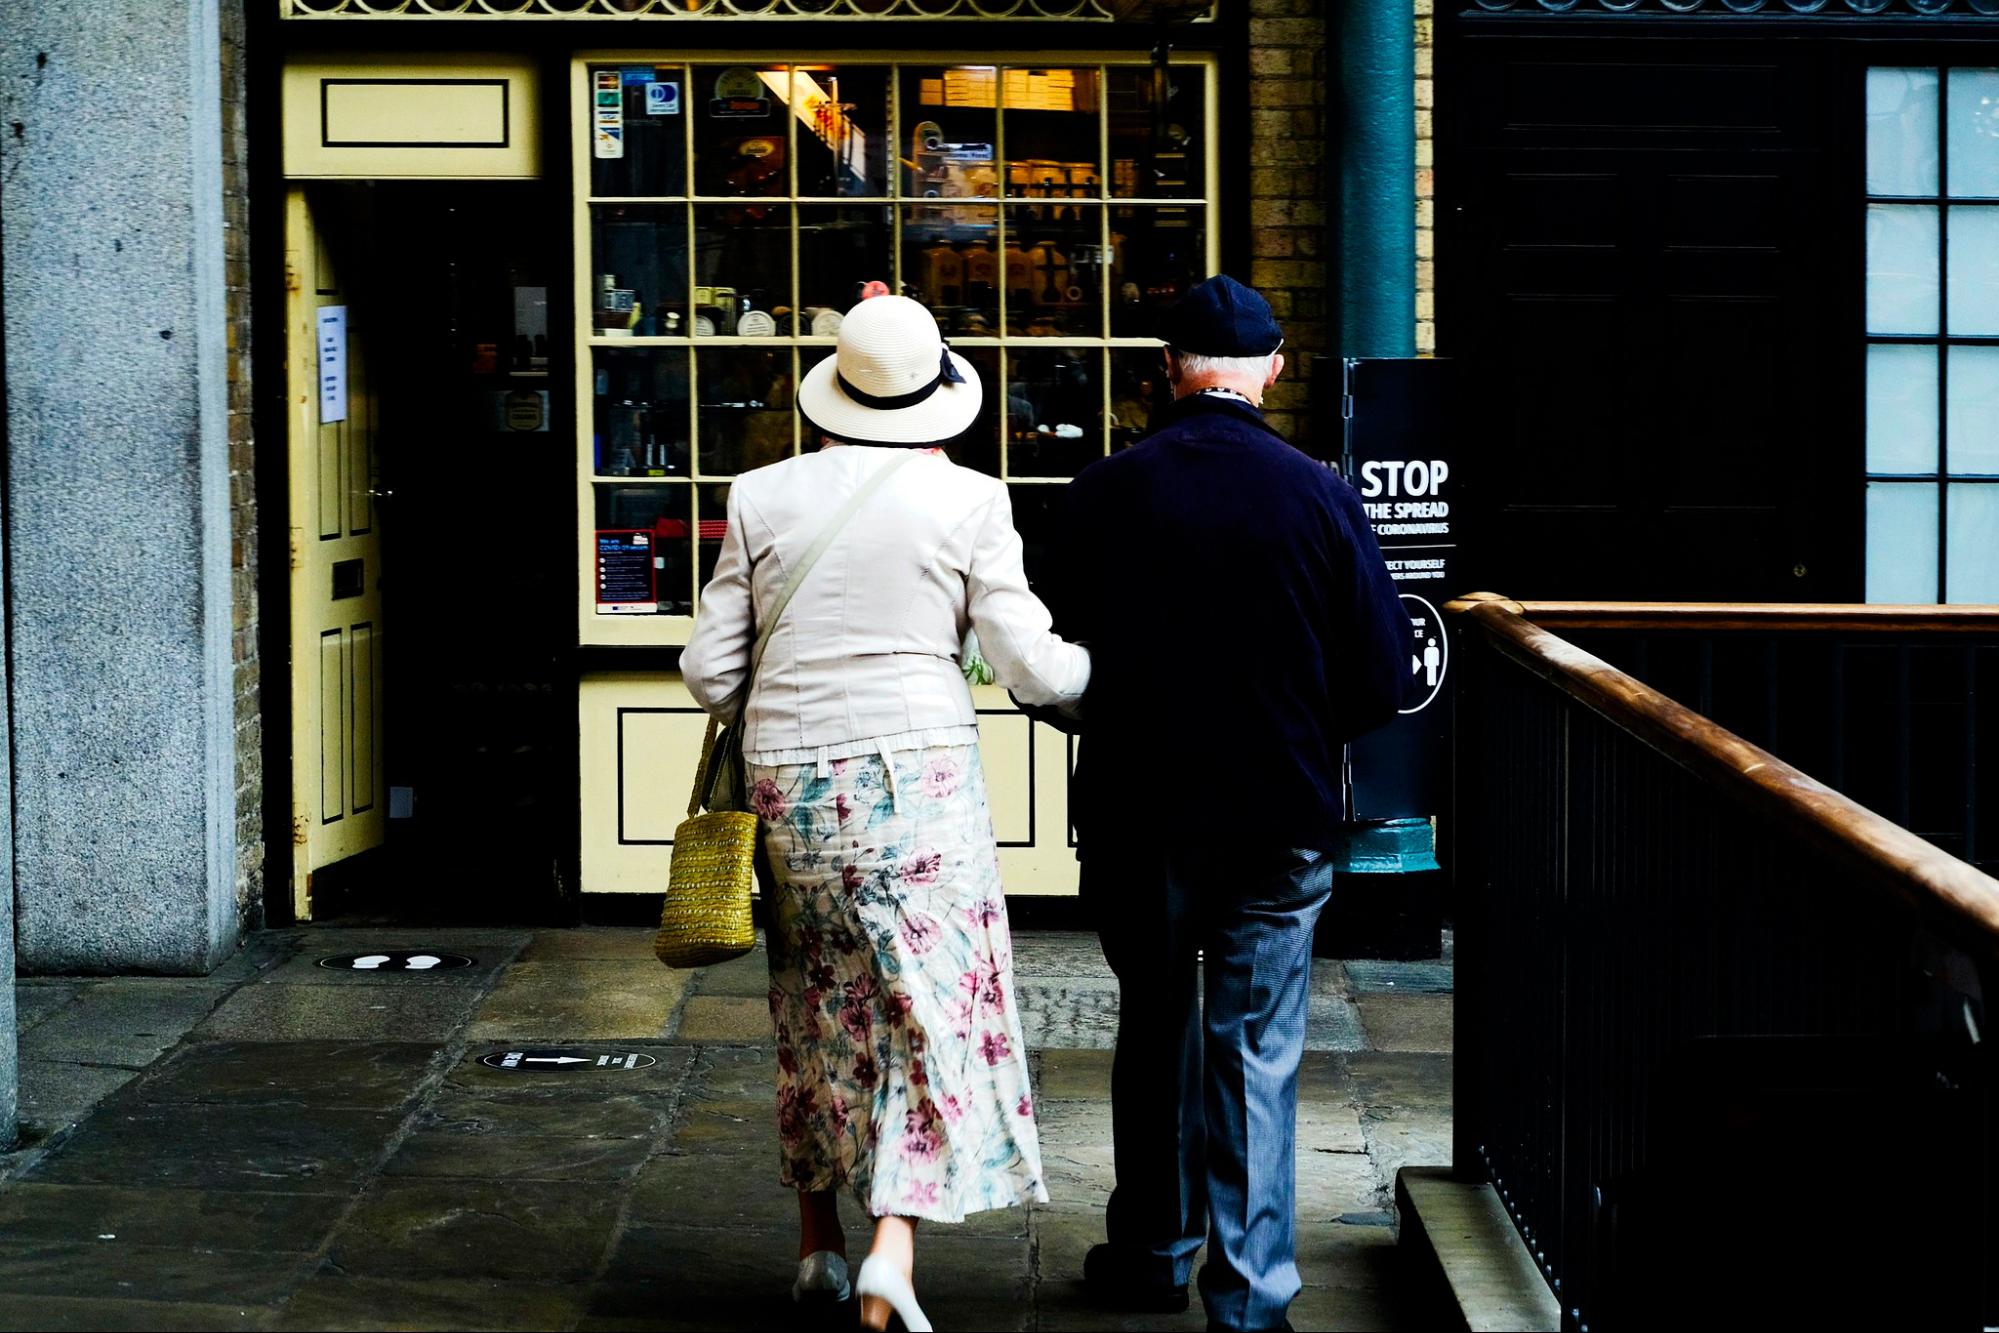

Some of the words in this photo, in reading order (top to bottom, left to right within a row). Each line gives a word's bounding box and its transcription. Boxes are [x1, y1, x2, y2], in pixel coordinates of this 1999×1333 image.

[1361, 460, 1449, 497] STOP
[1362, 503, 1392, 519] THE
[1394, 501, 1449, 519] SPREAD
[1377, 522, 1450, 535] CORONAVIRUS
[1404, 559, 1446, 569] YOURSELF
